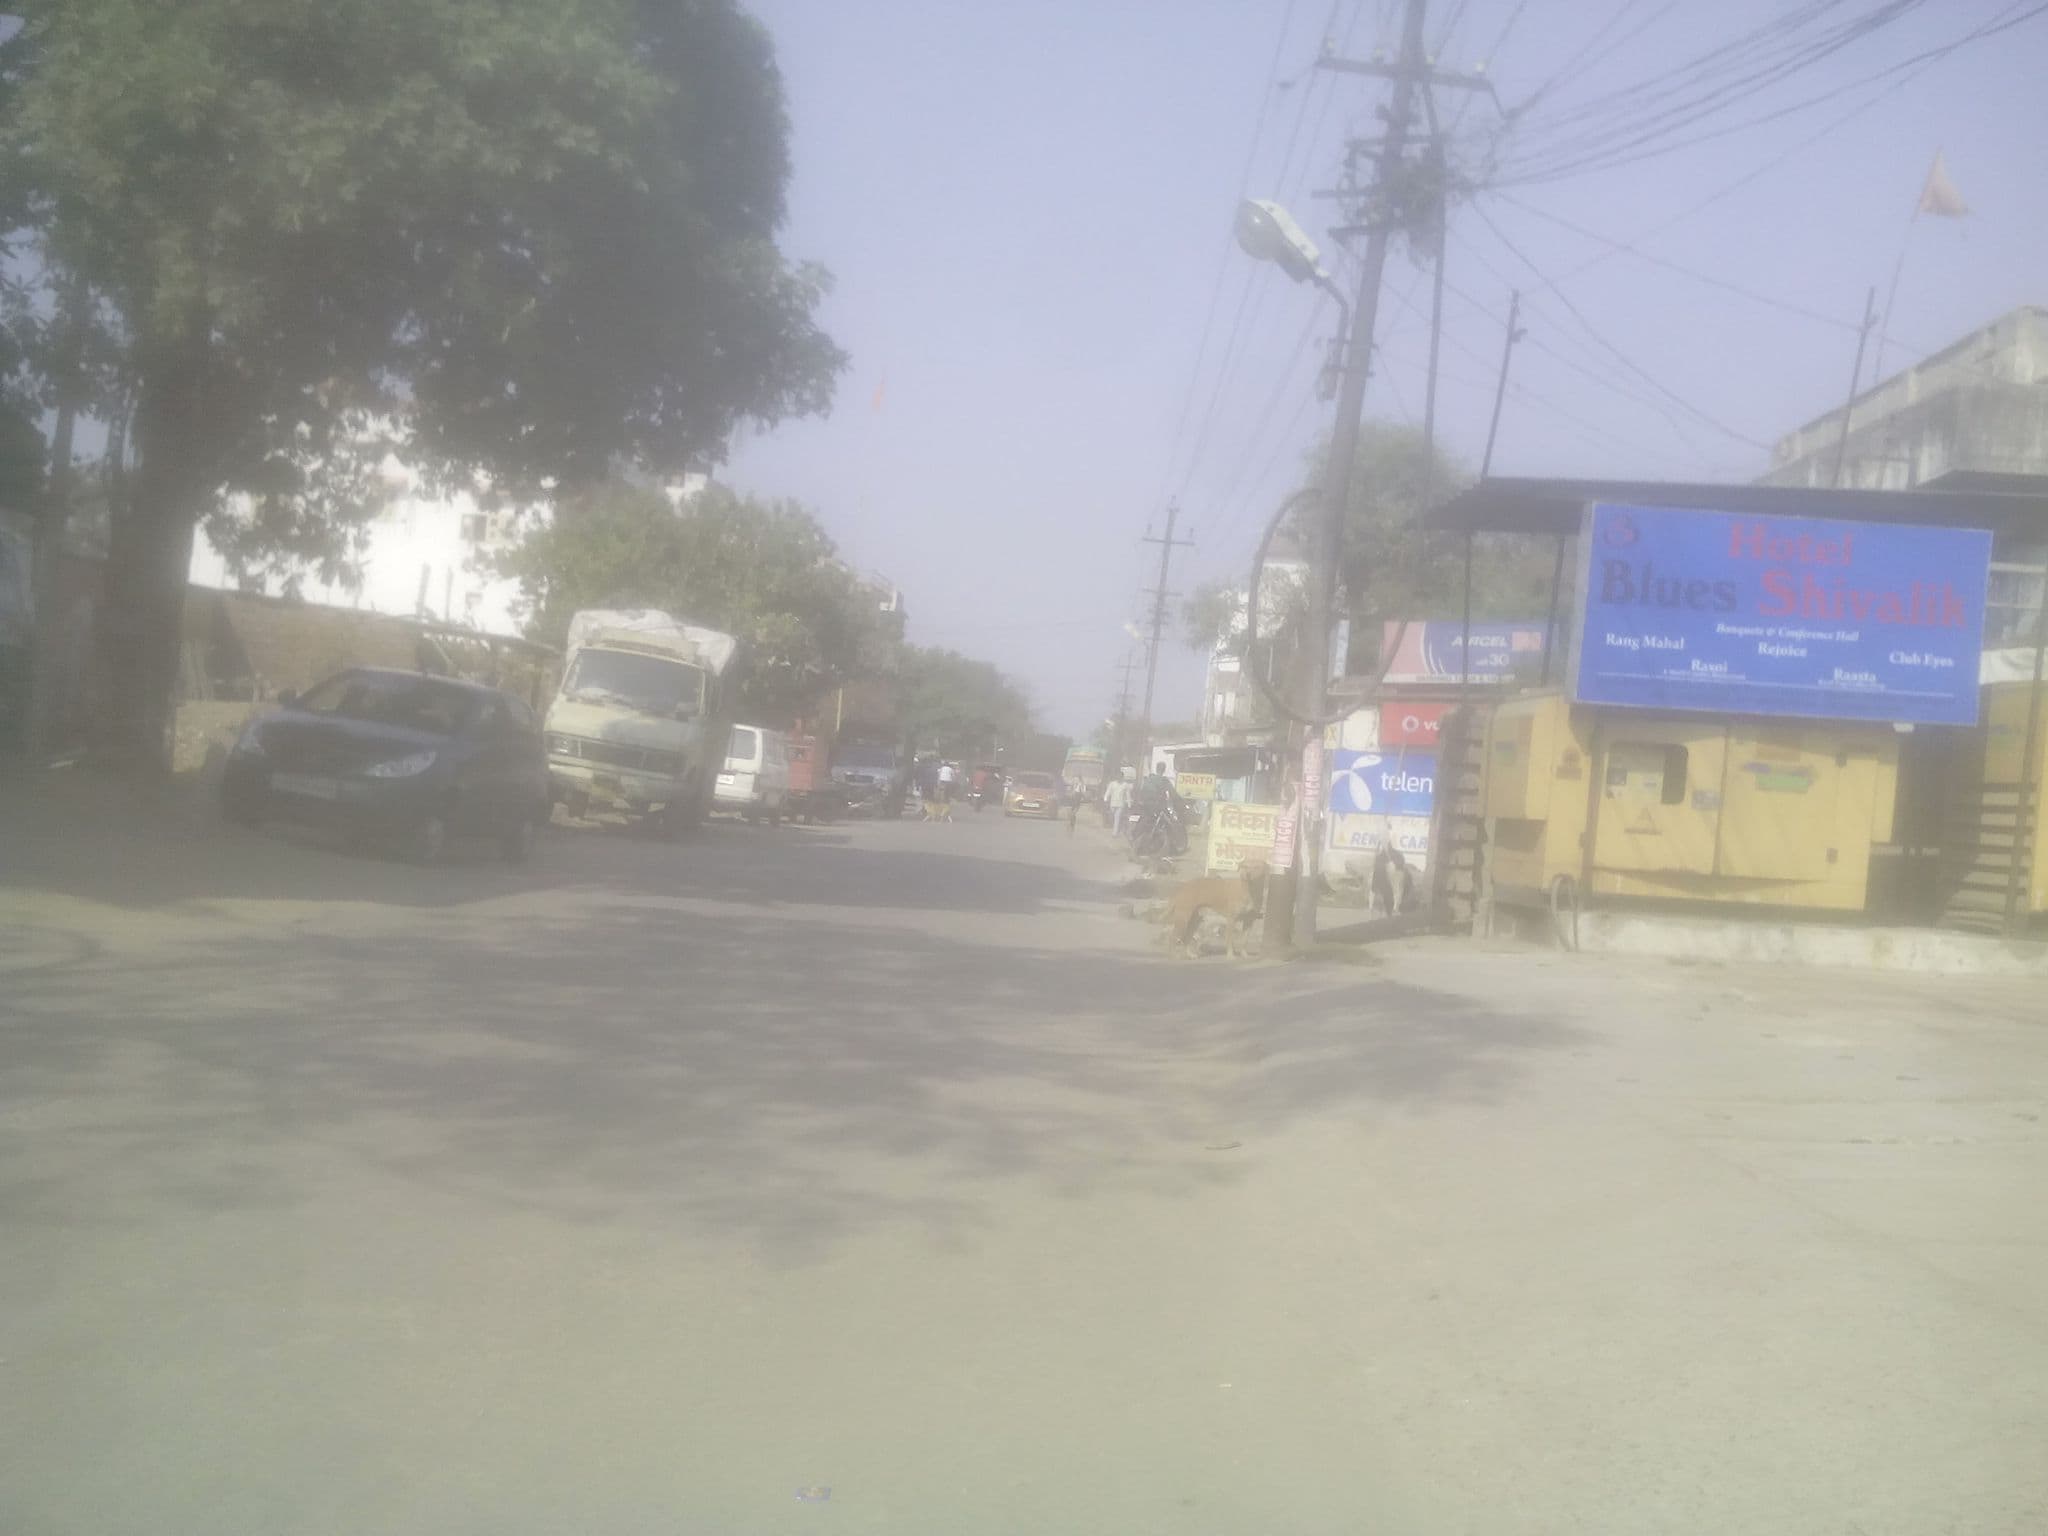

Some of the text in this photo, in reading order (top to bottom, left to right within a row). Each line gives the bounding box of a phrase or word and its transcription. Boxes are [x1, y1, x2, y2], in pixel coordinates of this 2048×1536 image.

[1728, 520, 1854, 566] Hotel
[1601, 558, 1738, 613] Blues
[1758, 568, 1967, 629] Shivalik
[1643, 635, 1685, 649] Mahal
[1836, 631, 1860, 641] Hall
